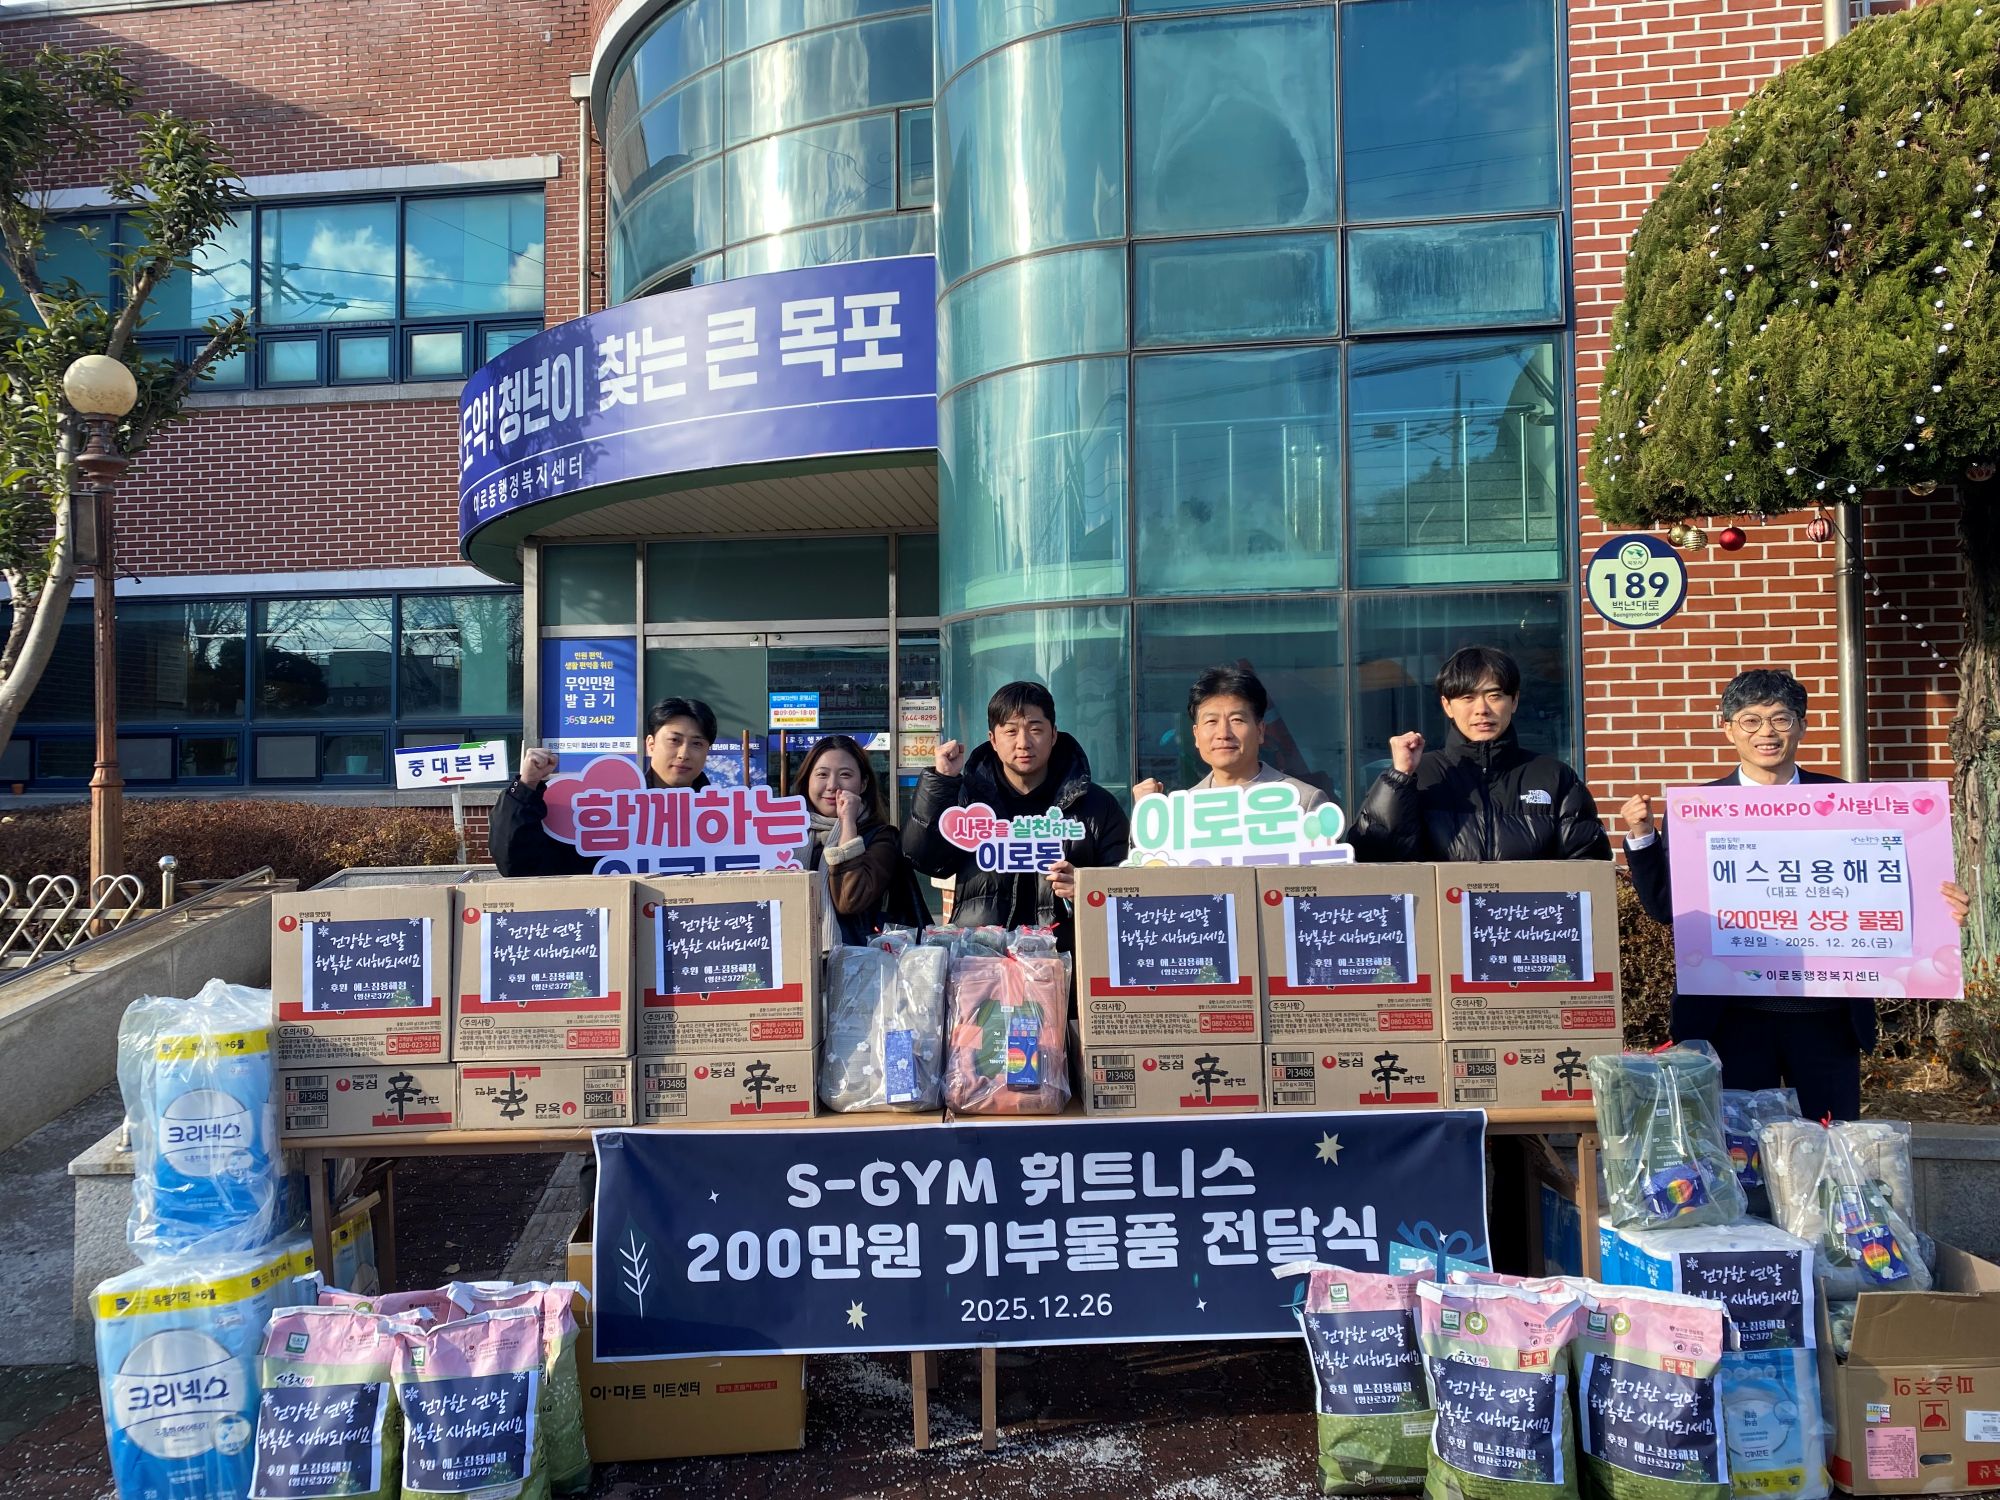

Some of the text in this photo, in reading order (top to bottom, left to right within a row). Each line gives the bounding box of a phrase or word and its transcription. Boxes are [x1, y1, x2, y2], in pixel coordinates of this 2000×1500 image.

[463, 291, 904, 471] 도약! 청년이 찾는 큰 목포
[473, 453, 583, 517] 이로동행정복지센터
[1604, 571, 1670, 599] 189
[1612, 600, 1660, 611] 백년대로
[564, 676, 616, 691] 무인민원
[564, 715, 616, 725] 365일 24시간
[902, 745, 936, 757] 5364
[407, 752, 497, 778] 중대본부
[1744, 801, 1811, 818] MOKPO
[1837, 795, 1910, 815] 사랑나눔
[576, 790, 806, 852] 함께하는
[952, 815, 1085, 840] 사랑을 실천하는
[1136, 786, 1299, 851] 이로운
[1881, 836, 1903, 851] 목포
[978, 841, 1063, 873] 이로동
[1712, 858, 1902, 884] 에스짐용해점
[1766, 886, 1850, 899] (대표 신현숙)
[680, 913, 755, 933] 건강한 연말
[1134, 907, 1211, 927] 건강한 연말
[1312, 907, 1389, 927] 건강한 연말
[1488, 904, 1565, 925] 건강한 연말
[1717, 909, 1905, 932] [200만원 상당 물품]
[330, 931, 407, 951] 건강한 연말
[508, 921, 584, 942] 건강한 연말
[1121, 929, 1227, 951] 행복한 새해되세요
[1298, 929, 1406, 951] 행복한 새해되세요
[1473, 926, 1580, 947] 행복한 새해되세요
[666, 935, 770, 960] 행복한 새해되세요
[1730, 936, 1894, 949] 후원일 2025. 12. 26.(금)
[315, 953, 422, 976] 행복한 새해되세요
[493, 943, 599, 967] 행복한 새해되세요
[1136, 957, 1213, 968] 후원 에스짐용해점
[1488, 954, 1567, 964] 후원 에스짐용해점
[330, 981, 407, 993] 후원 에스짐용해점
[1766, 970, 1880, 983] 이로동행정복지센터
[1094, 1002, 1122, 1011] 주의사항
[1272, 1002, 1301, 1011] 주의사항
[1455, 999, 1483, 1007] 주의사항
[1158, 1060, 1184, 1071] 농심
[1338, 1057, 1364, 1068] 농심
[1520, 1053, 1546, 1065] 농심
[710, 1067, 736, 1078] 농심
[1107, 1071, 1134, 1081] 가3486
[1191, 1052, 1229, 1104] 辛
[1371, 1050, 1408, 1101] 辛
[1403, 1074, 1426, 1084] 라면
[1468, 1065, 1496, 1075] 가3486
[1553, 1046, 1588, 1097] 辛
[351, 1079, 378, 1091] 농심
[658, 1079, 686, 1089] 가3486
[742, 1059, 780, 1111] 辛
[774, 1084, 797, 1094] 라면
[1223, 1077, 1247, 1088] 라면
[384, 1071, 422, 1122] 辛
[416, 1095, 440, 1106] 라면
[167, 1122, 242, 1144] 크리넥스
[786, 1147, 1257, 1209] S-GYM 휘트니스
[687, 1205, 1381, 1283] 200만원 기부물품 전달식
[1700, 1263, 1784, 1286] 건강한 연말
[152, 1290, 191, 1306] 특별기획
[960, 1293, 1114, 1322] 2025.12.26
[1731, 1288, 1801, 1307] 새해되세요
[1322, 1323, 1405, 1347] 건강한 연말
[1314, 1349, 1422, 1376] 행복한 새해되세요
[1521, 1352, 1547, 1367] 햅쌀
[128, 1375, 230, 1412] 크리넥스
[653, 1381, 701, 1398] 미트센터
[1446, 1379, 1538, 1412] 건강한 연말
[1893, 1375, 1975, 1396] 파손주의
[419, 1389, 509, 1416] 건강한 연말
[1610, 1378, 1702, 1417] 건강한 연말
[272, 1399, 358, 1424] 건강한 연말
[1476, 1410, 1552, 1434] 새해되세요
[1591, 1395, 1715, 1436] 행복한 새해되세요
[445, 1416, 524, 1439] 새해되세요
[1607, 1433, 1700, 1461] 후원 에스짐용해점
